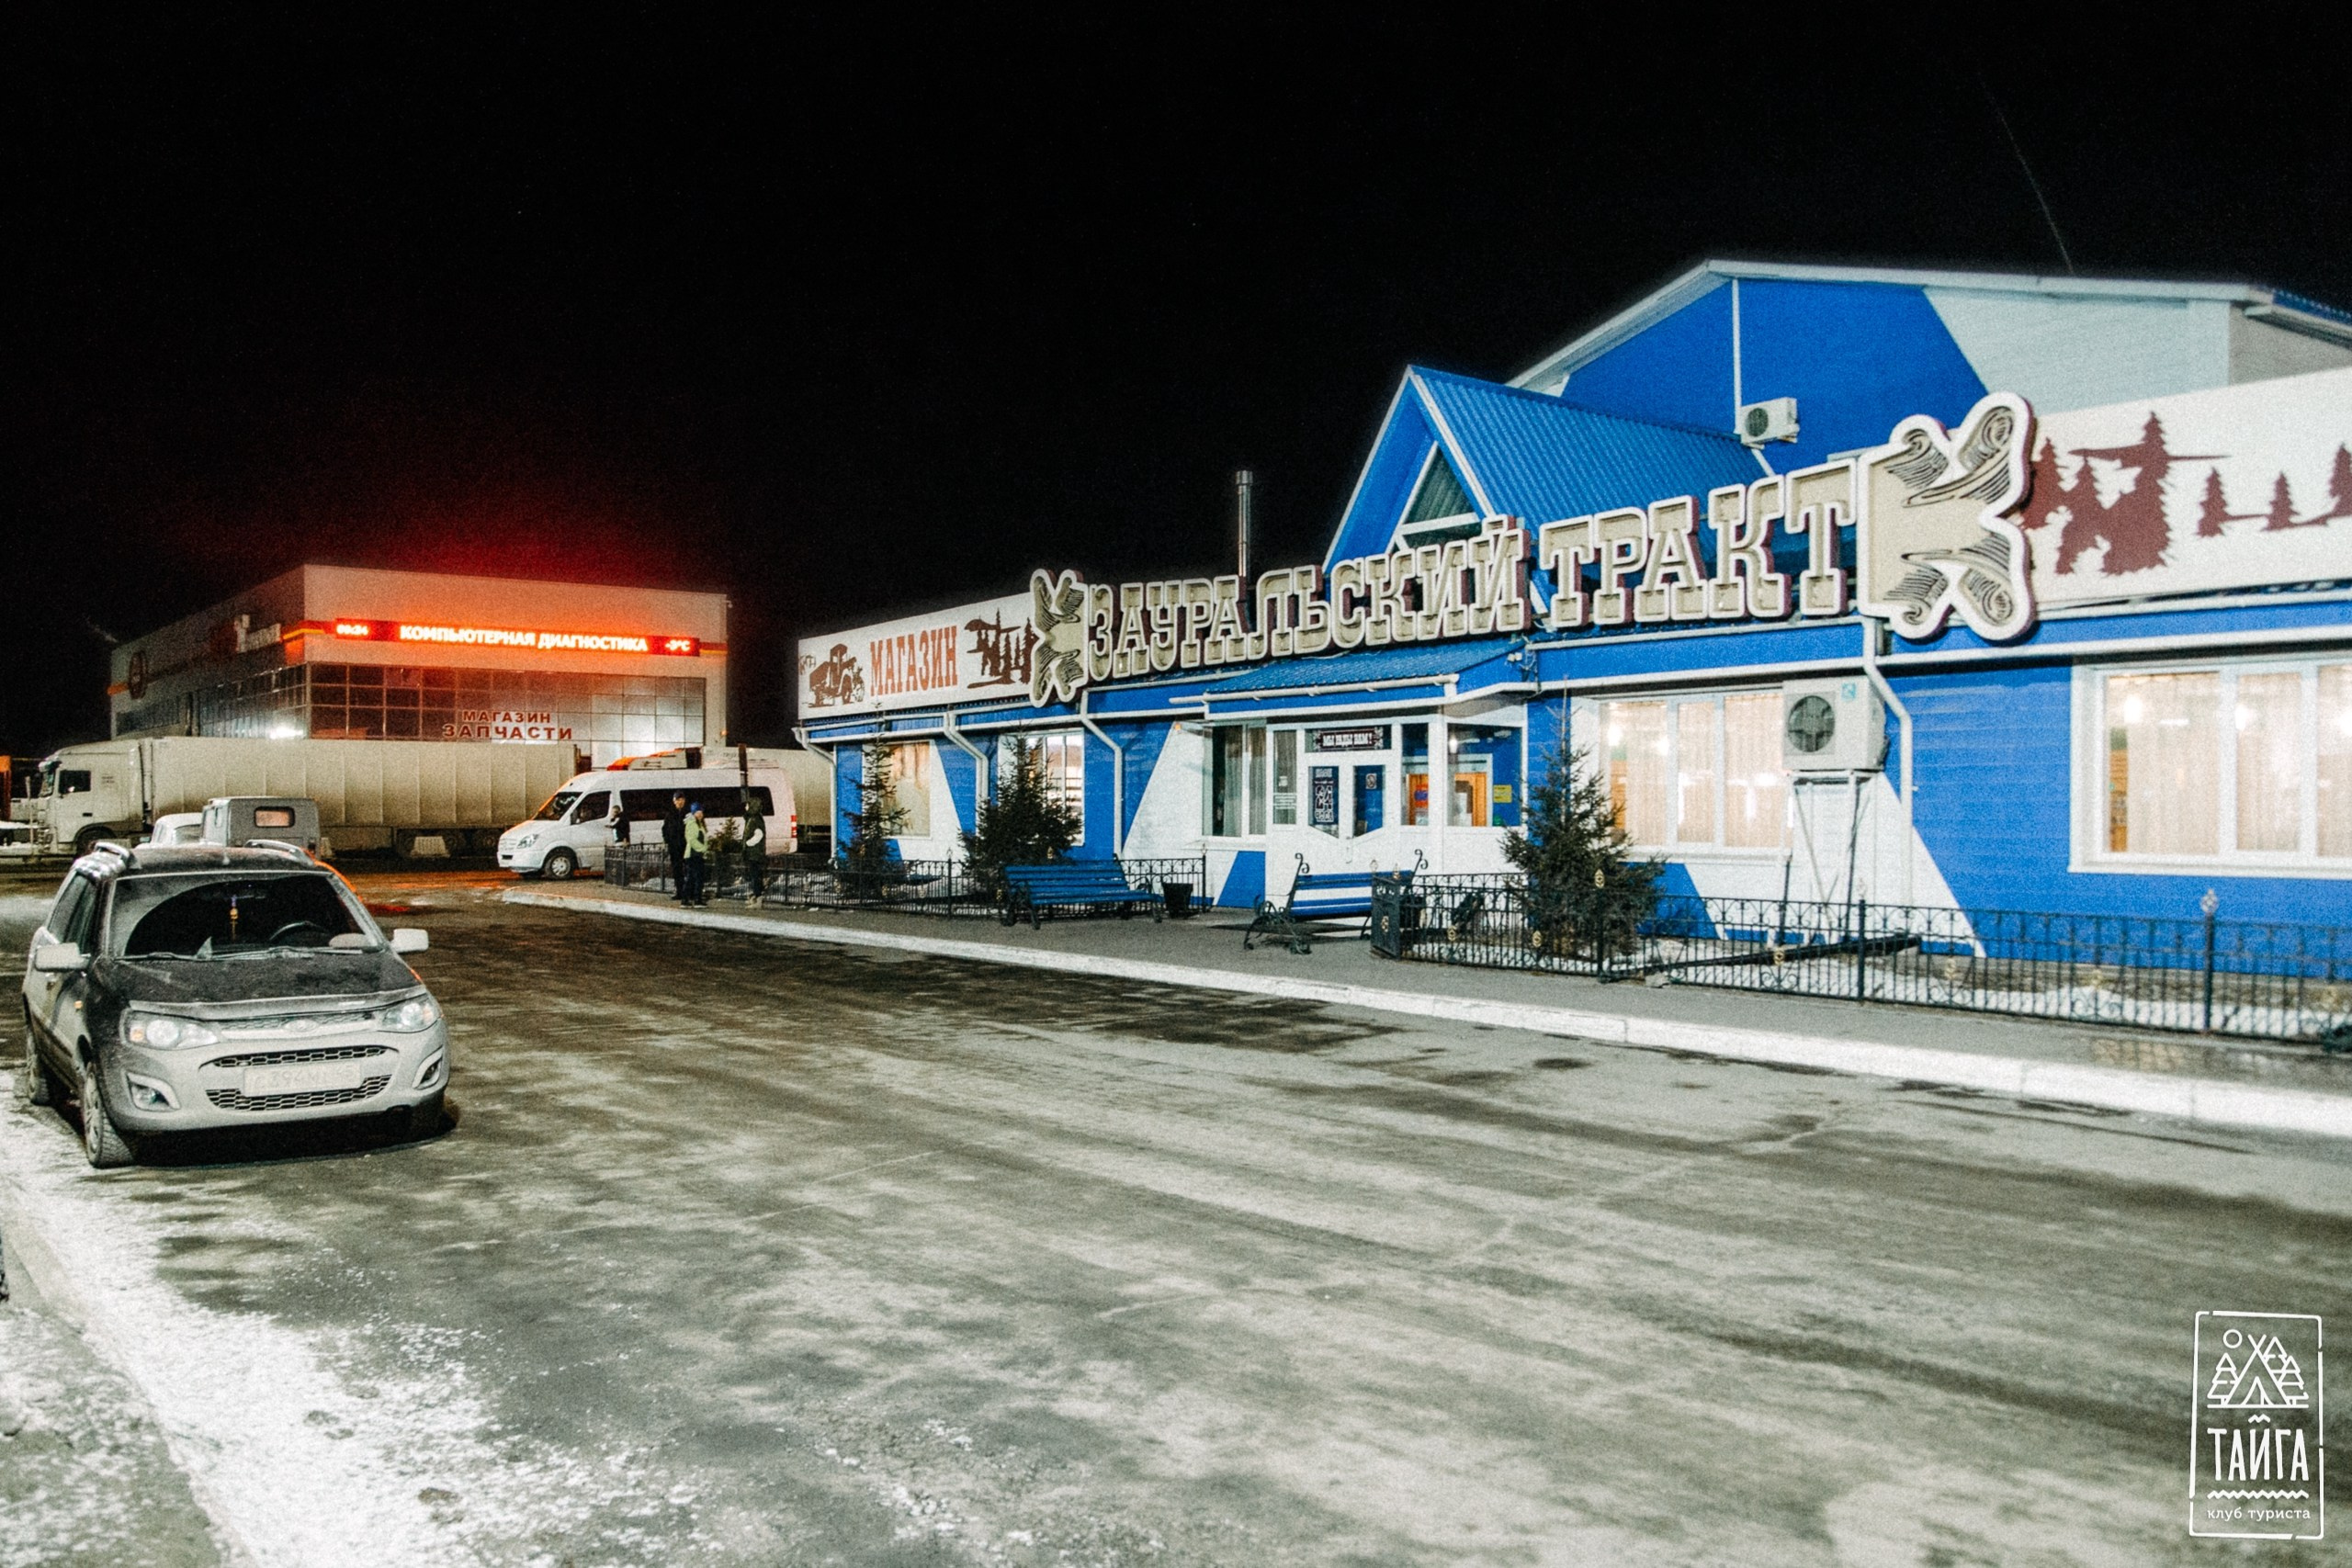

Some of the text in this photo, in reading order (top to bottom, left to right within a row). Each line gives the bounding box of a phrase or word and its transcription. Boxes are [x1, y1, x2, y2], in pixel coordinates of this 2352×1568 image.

[1087, 458, 1858, 682] ЗАУРАЛЬСКИЙ ТРАКТ
[400, 626, 649, 652] КОМПЬЮТЕРНАЯ ДИАГНОСТИКА
[869, 626, 957, 696] МАГАЗИН
[462, 710, 551, 724] МАГАЗИН
[443, 724, 572, 740] ЗАПЧАСТИ
